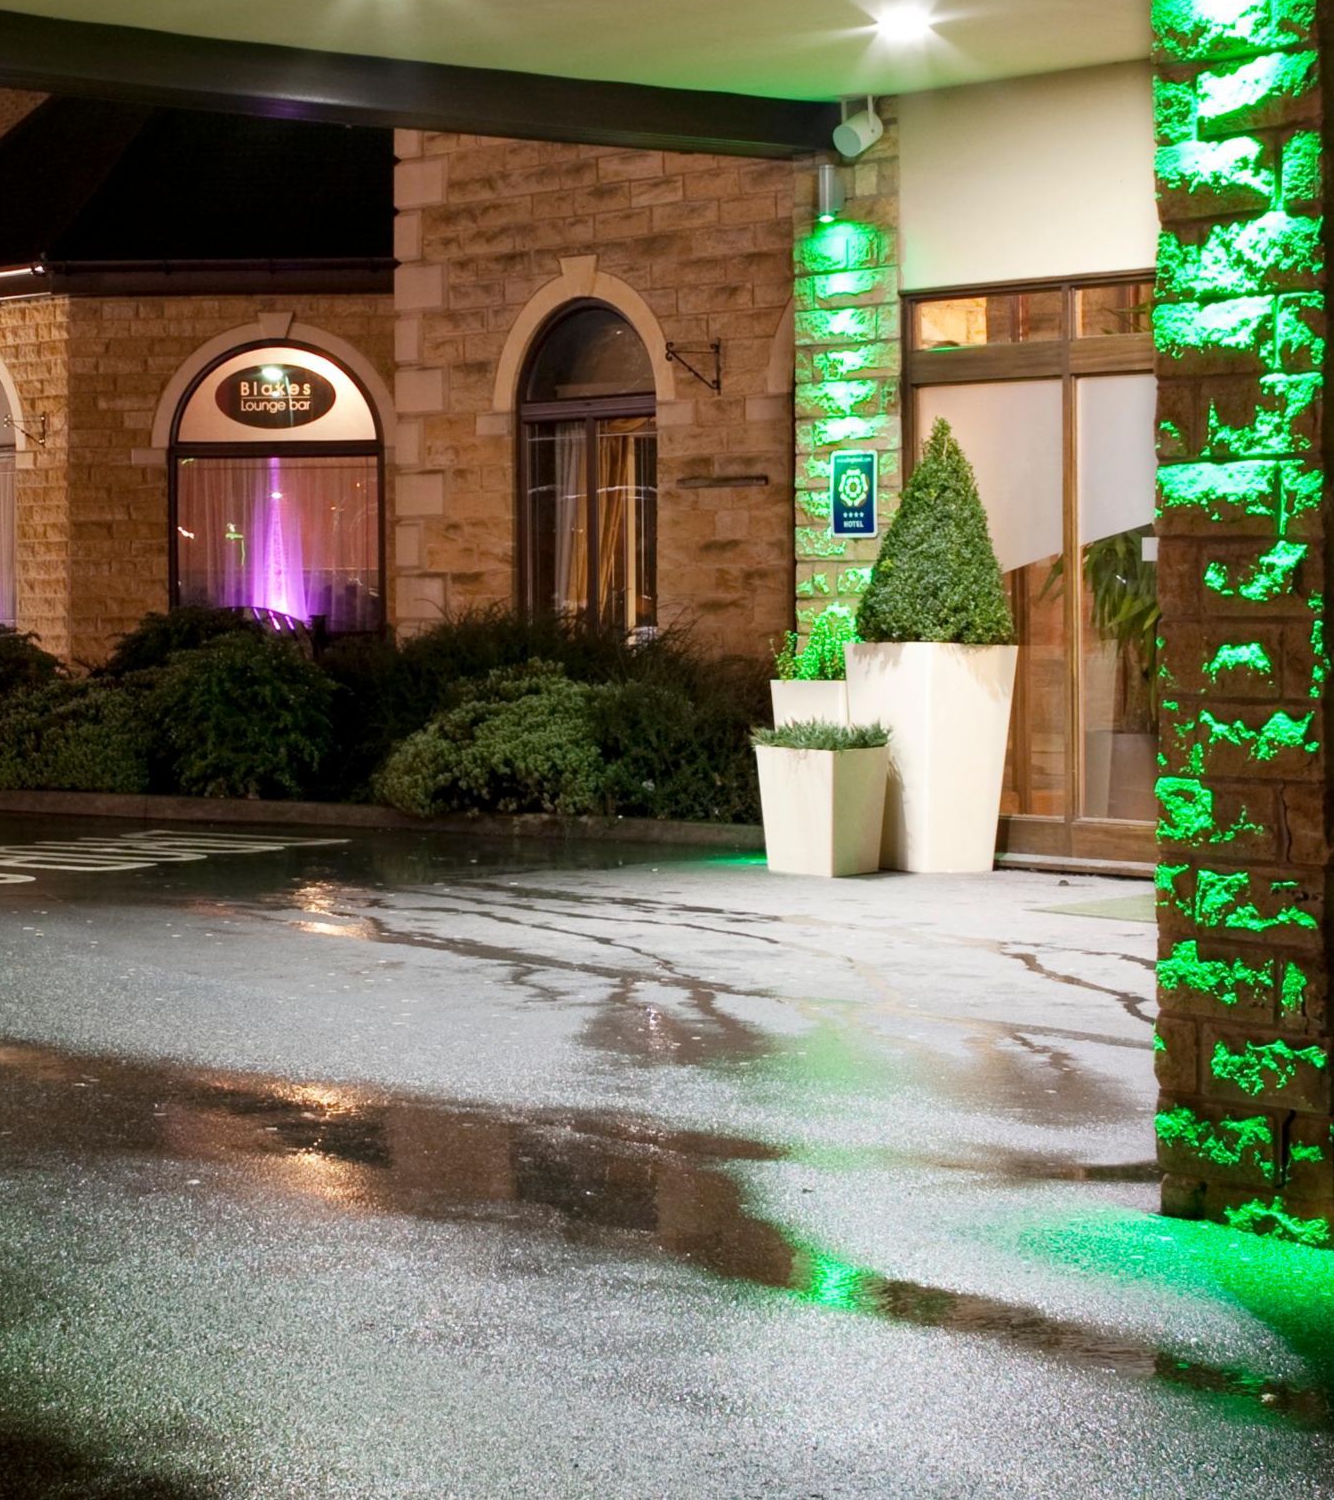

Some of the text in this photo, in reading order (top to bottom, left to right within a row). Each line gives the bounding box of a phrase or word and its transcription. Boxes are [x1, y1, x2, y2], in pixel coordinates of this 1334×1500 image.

[241, 381, 311, 396] Blakes
[241, 399, 311, 414] Lounge bar
[843, 520, 864, 528] HOTEL
